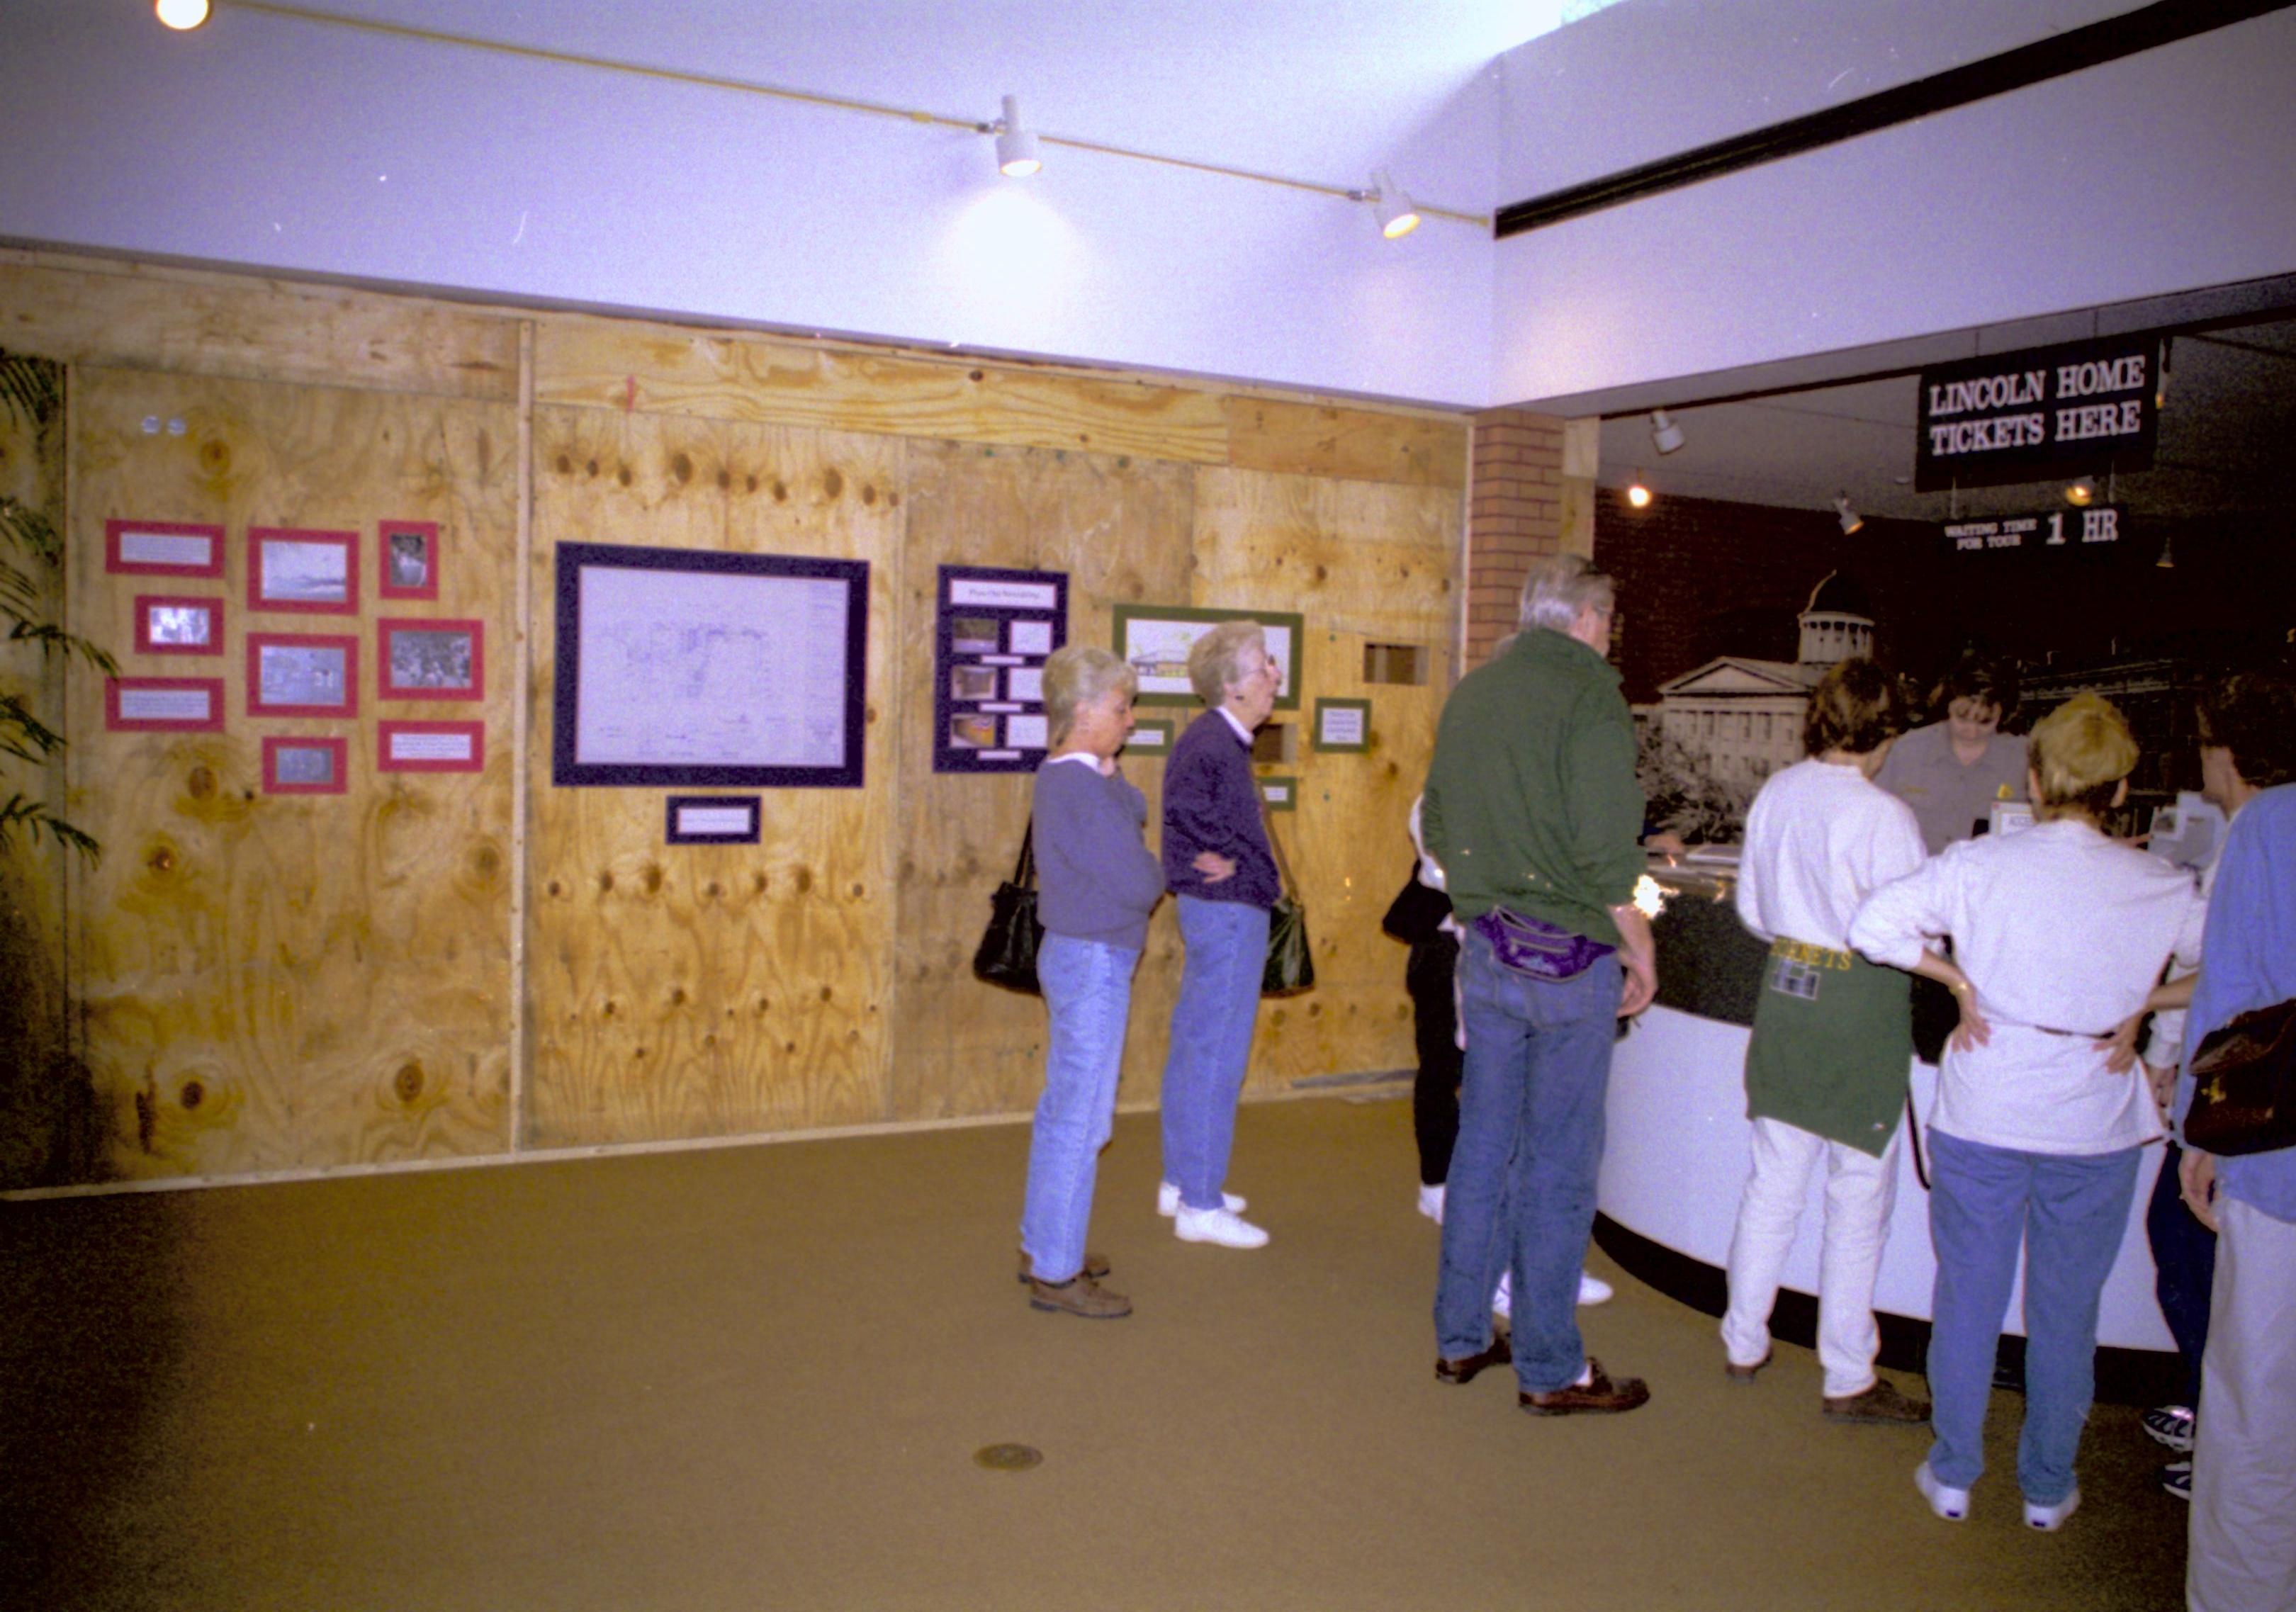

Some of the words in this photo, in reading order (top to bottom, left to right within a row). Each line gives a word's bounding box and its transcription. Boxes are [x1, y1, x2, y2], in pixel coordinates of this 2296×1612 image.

[1929, 370, 2047, 416] LINCOLN
[2056, 354, 2146, 399] HOME
[1929, 412, 2045, 456] TICKETS
[2054, 400, 2141, 442] HERE
[1944, 522, 1998, 538] WAITING
[2003, 518, 2037, 533] TIME
[1957, 536, 1983, 551] FOR
[1986, 534, 2021, 548] TOUR
[2046, 512, 2066, 545] 1
[2081, 509, 2119, 543] HR
